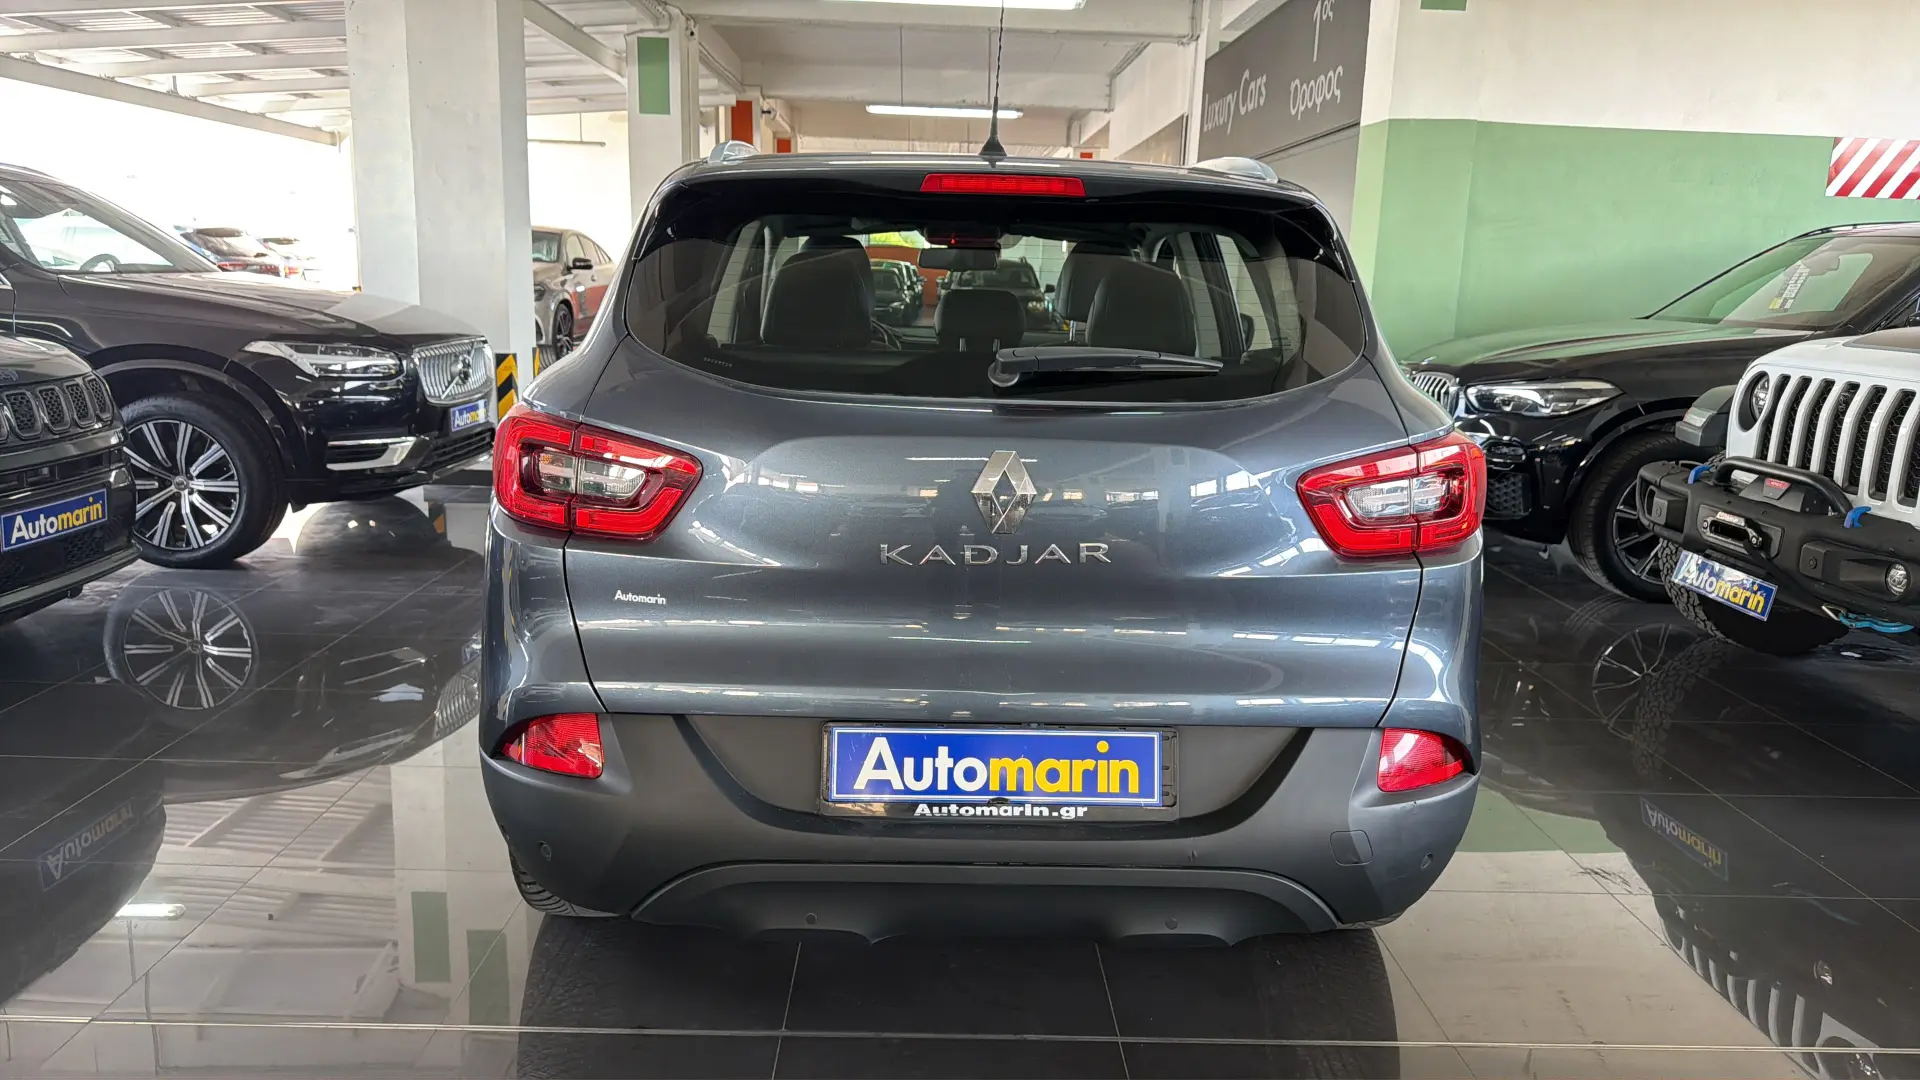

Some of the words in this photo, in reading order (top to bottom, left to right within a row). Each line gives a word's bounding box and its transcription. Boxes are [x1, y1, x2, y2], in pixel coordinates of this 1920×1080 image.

[1203, 90, 1238, 135] Luxury
[1239, 69, 1267, 115] Cars
[10, 496, 103, 544] Automarin
[880, 542, 1112, 566] KADJAR
[614, 589, 667, 605] Automarin
[1678, 553, 1766, 613] Automarin
[853, 736, 1139, 793] Automarin
[913, 803, 1088, 819] Automarin.gr
